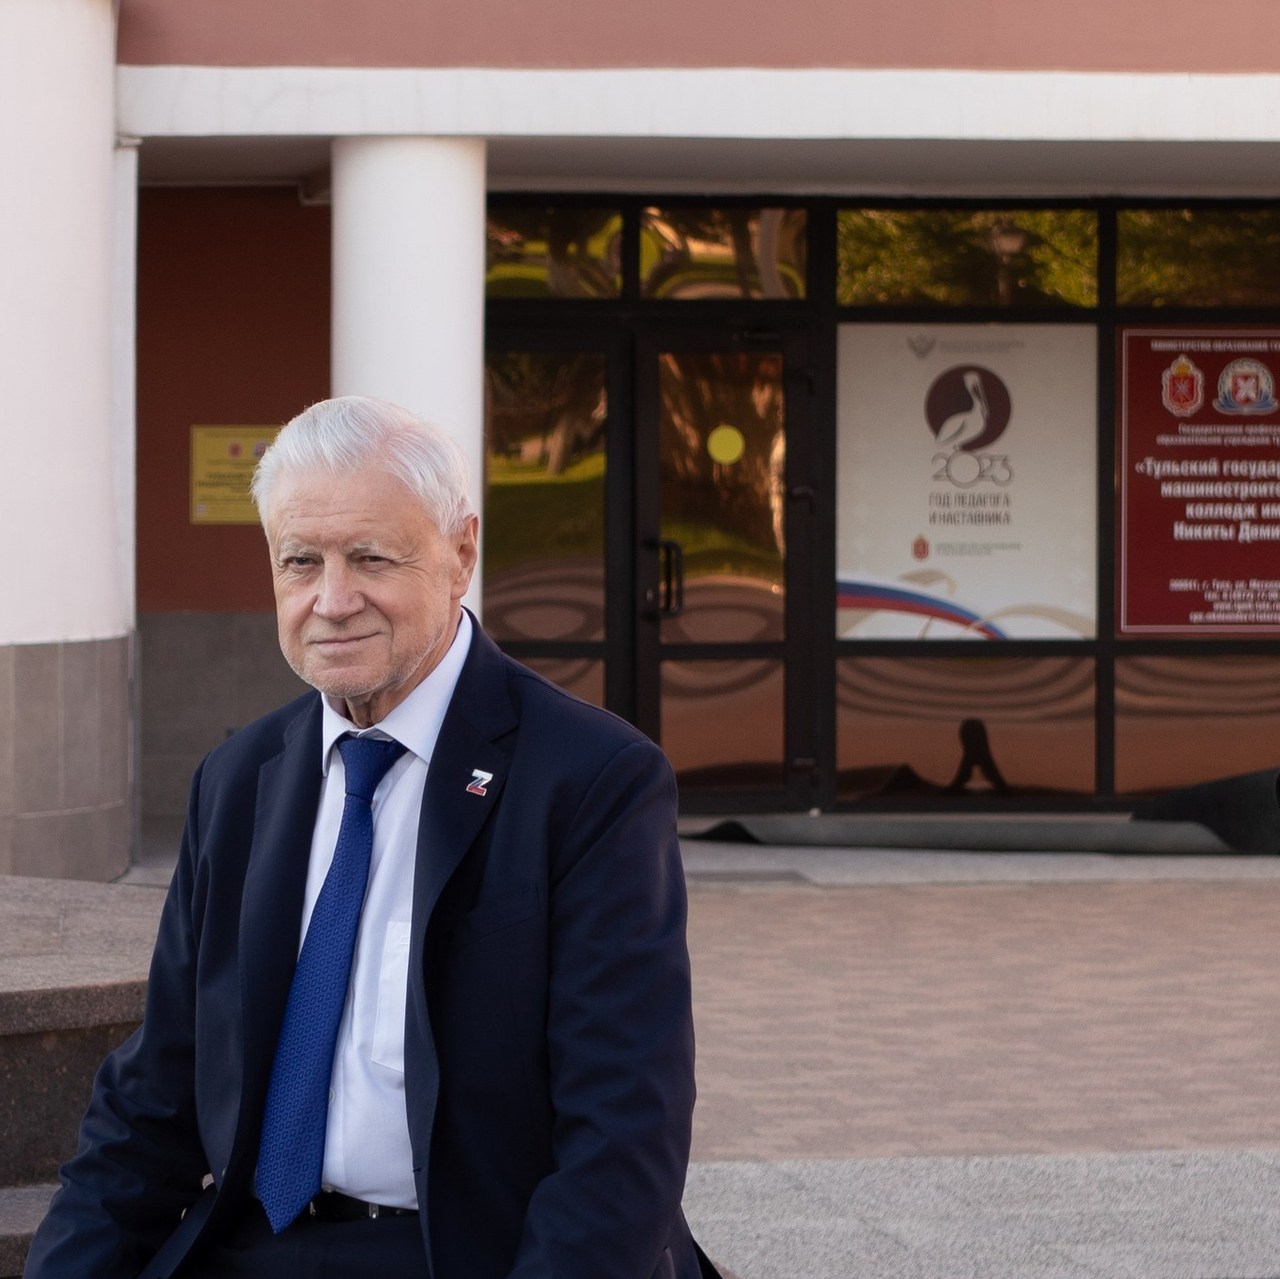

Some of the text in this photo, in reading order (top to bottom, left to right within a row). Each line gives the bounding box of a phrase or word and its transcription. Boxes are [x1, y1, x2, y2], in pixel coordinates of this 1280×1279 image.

[931, 452, 1014, 489] 2023
[1135, 456, 1219, 480] «Тульский
[929, 492, 1010, 509] ГОД ПЕДАГОГА
[928, 511, 1010, 525] И НАСТАВНИКА
[1186, 503, 1258, 521] колледж
[1174, 521, 1235, 540] Никиты
[466, 768, 493, 796] Z
